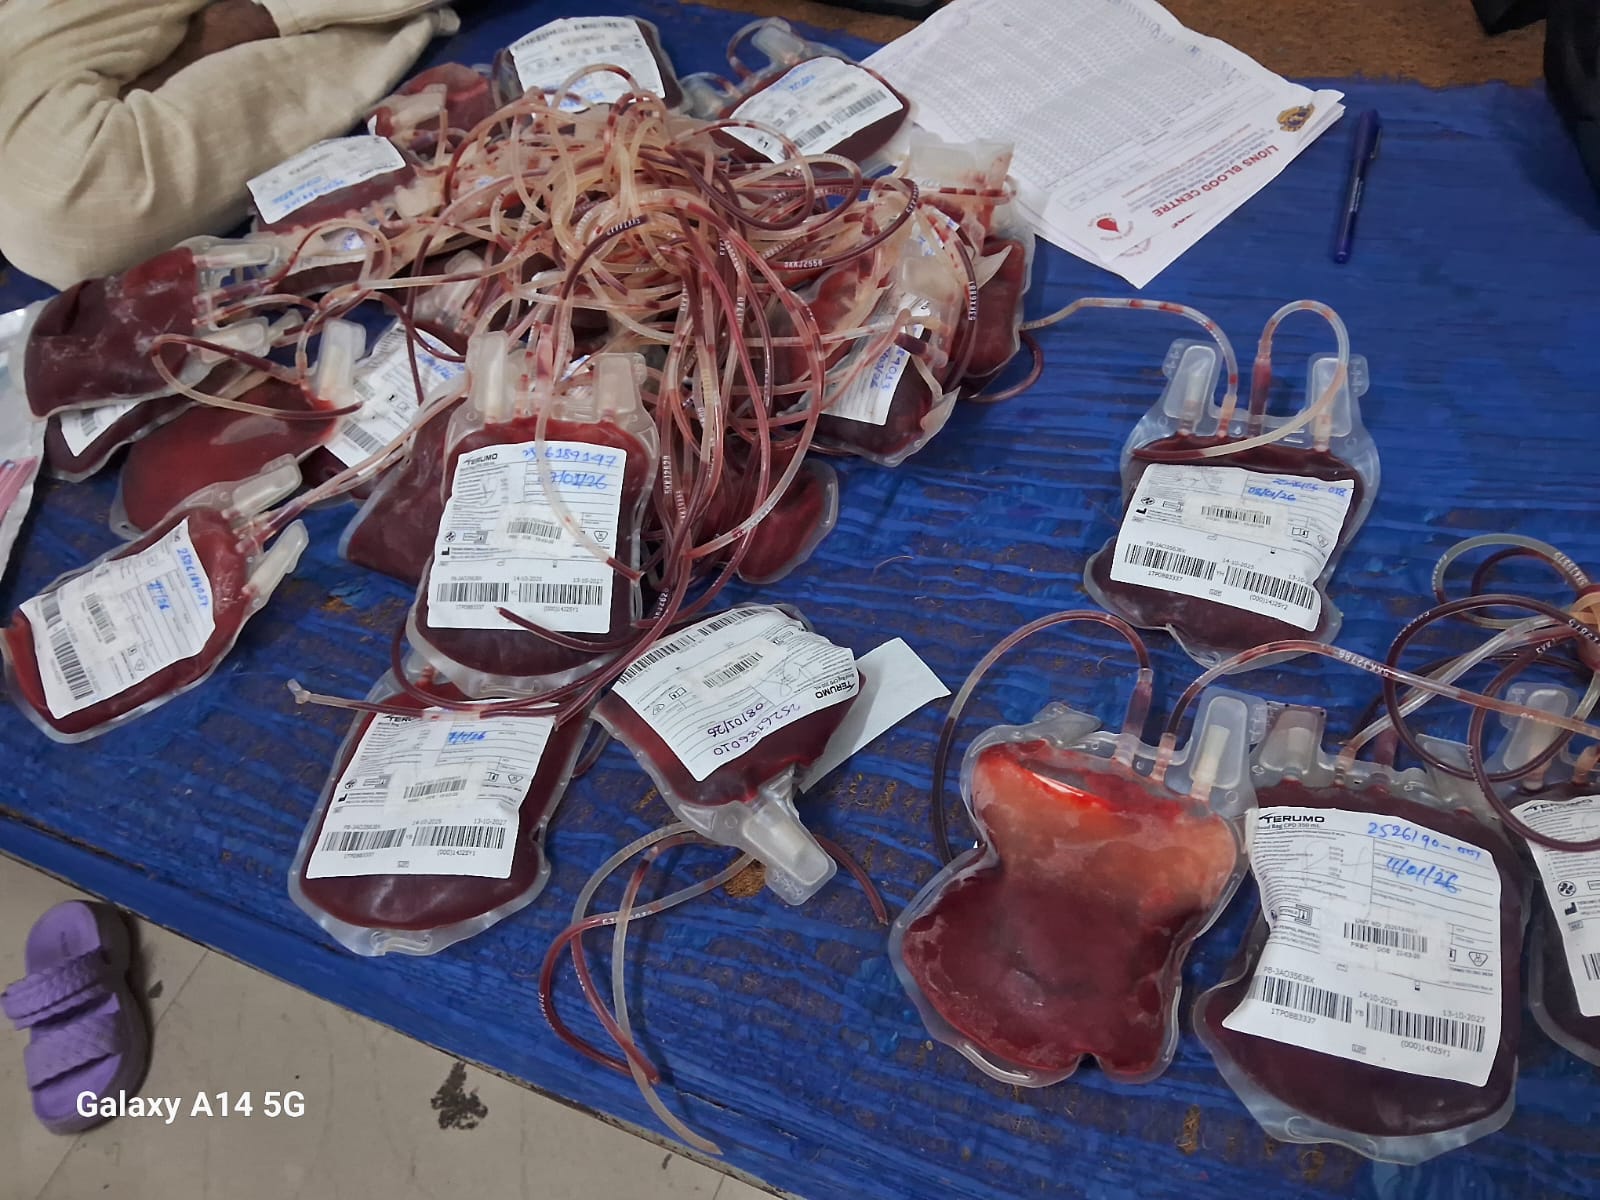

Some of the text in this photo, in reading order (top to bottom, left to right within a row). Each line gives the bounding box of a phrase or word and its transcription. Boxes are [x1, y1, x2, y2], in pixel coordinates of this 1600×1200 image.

[1152, 145, 1279, 218] LIONS BLOOD CENTRE
[464, 453, 498, 465] TERUMO
[815, 680, 856, 700] TERUMO
[1259, 812, 1324, 824] TERUMO
